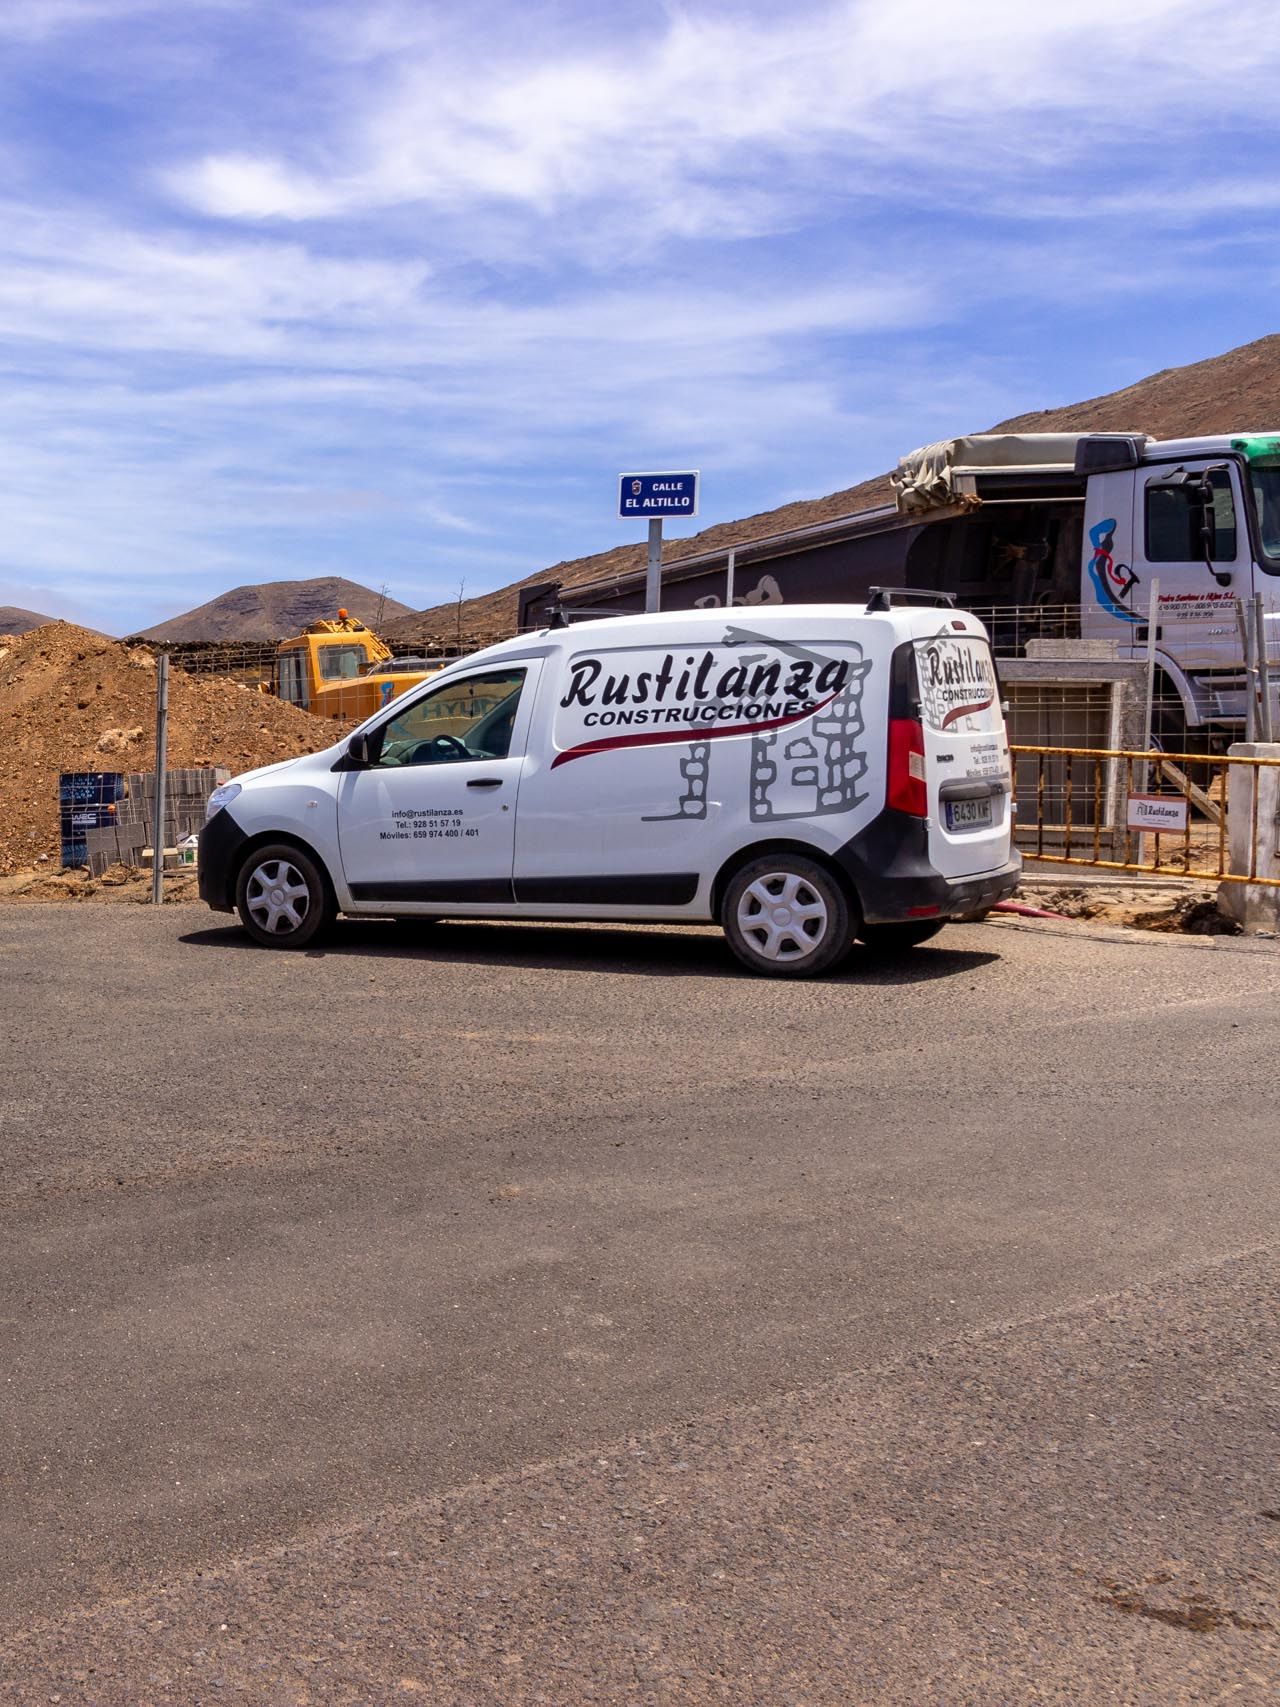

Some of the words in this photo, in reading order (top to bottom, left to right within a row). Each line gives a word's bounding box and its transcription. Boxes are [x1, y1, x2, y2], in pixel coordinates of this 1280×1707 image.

[652, 482, 684, 491] CALLE
[625, 498, 640, 508] EL
[642, 496, 690, 508] ALTILLO
[560, 650, 849, 708] Rustilanza
[583, 701, 817, 727] CONSTRUCCIONES
[392, 809, 464, 819] info@rustilanza.es
[953, 802, 977, 822] 6430
[396, 821, 412, 829] Tel.:
[413, 820, 427, 828] 928
[380, 831, 412, 840] Móviles:
[413, 830, 427, 839] 659
[429, 830, 443, 838] 974
[444, 829, 459, 837] 400
[465, 828, 480, 836] 401
